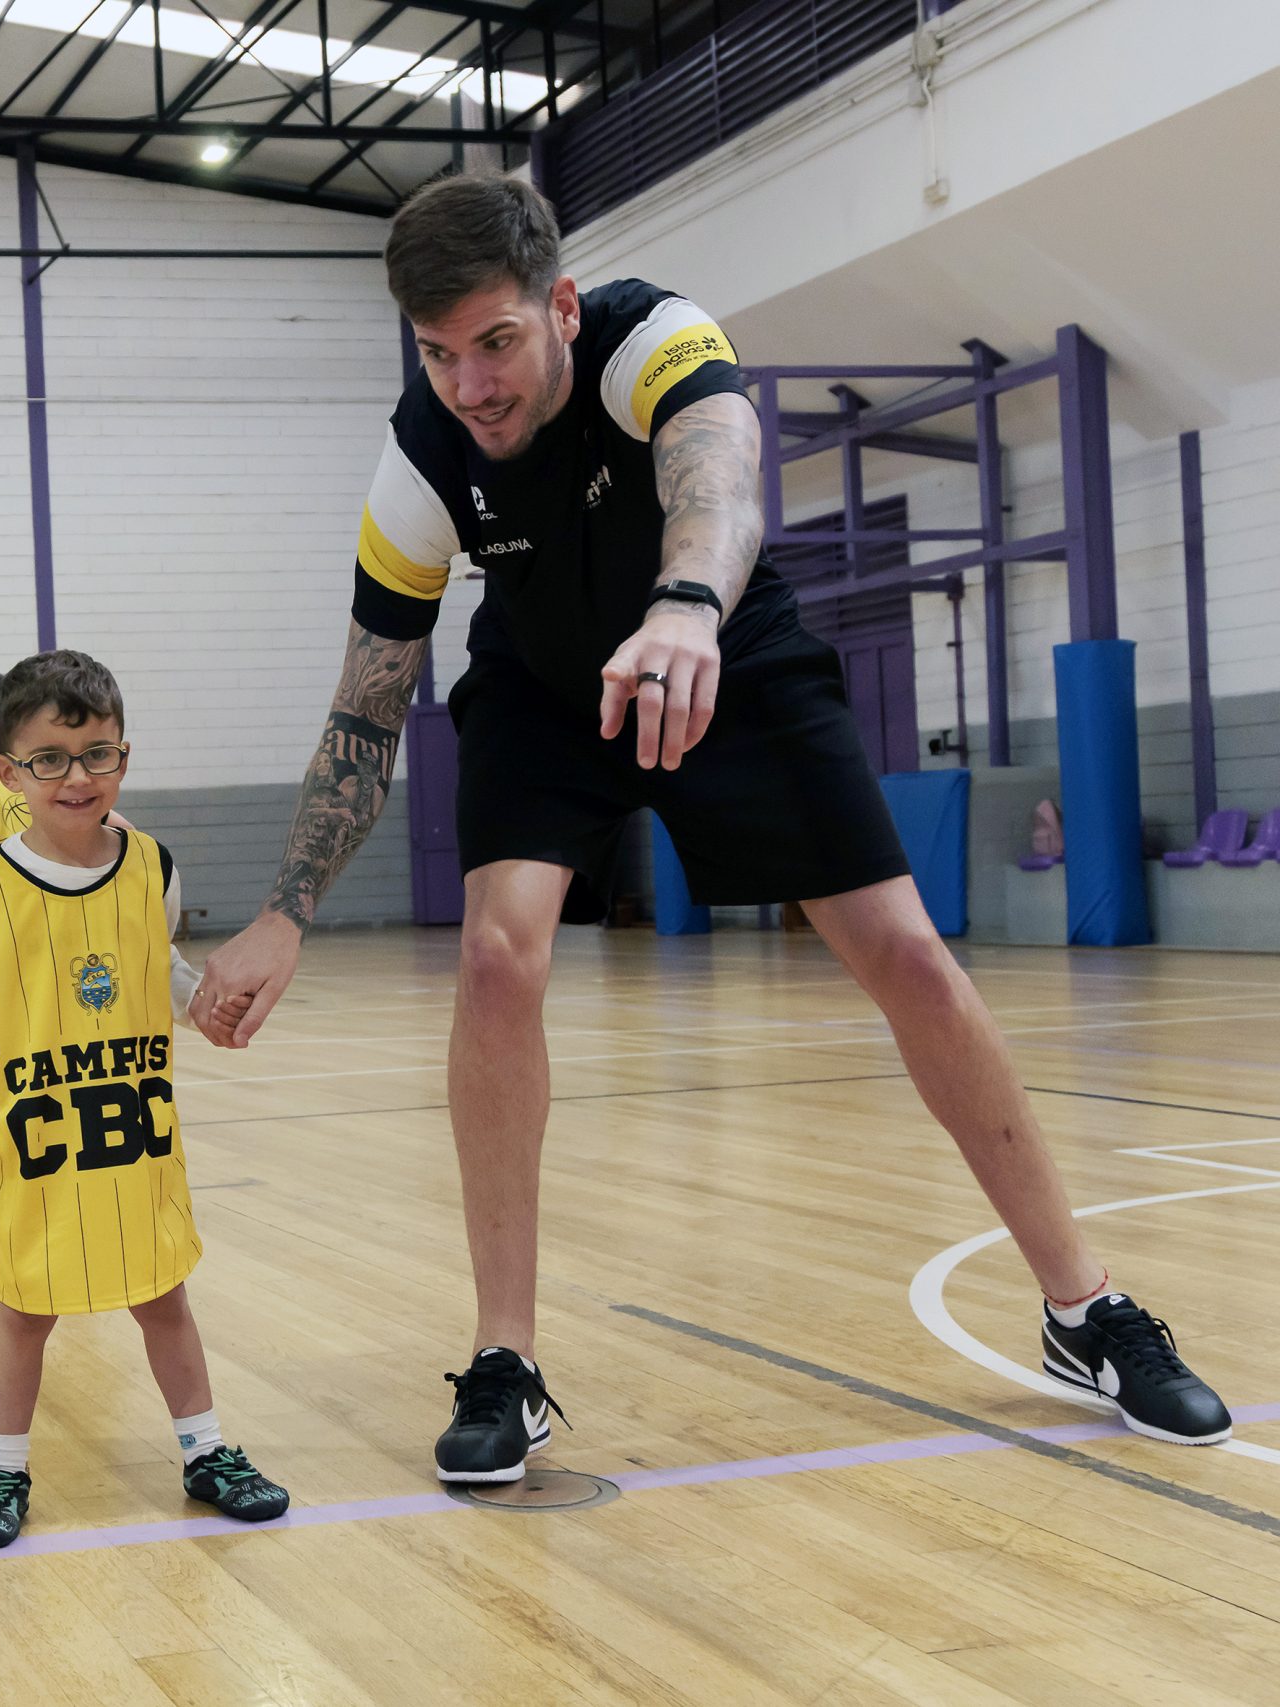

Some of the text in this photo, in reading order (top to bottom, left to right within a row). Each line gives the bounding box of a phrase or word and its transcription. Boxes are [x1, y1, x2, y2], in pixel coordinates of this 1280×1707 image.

[663, 340, 699, 356] Islas
[478, 537, 533, 555] LAGUNA
[3, 1034, 170, 1096] CAMPUS
[6, 1076, 173, 1181] CBC
